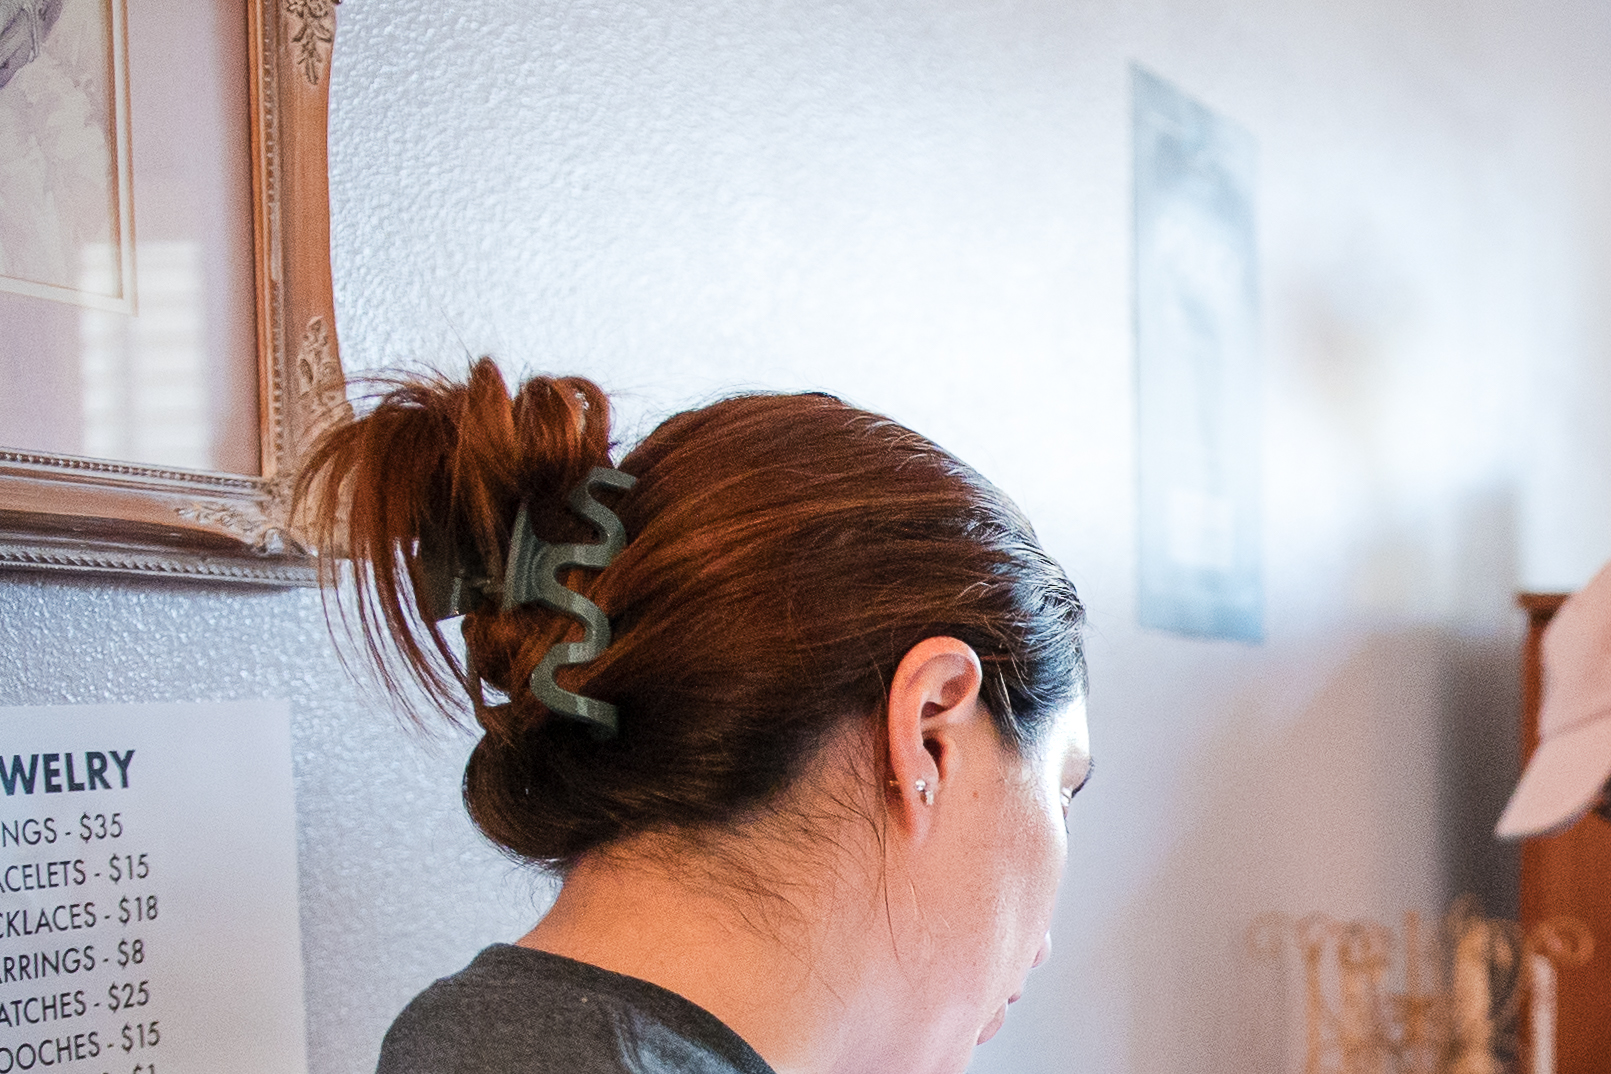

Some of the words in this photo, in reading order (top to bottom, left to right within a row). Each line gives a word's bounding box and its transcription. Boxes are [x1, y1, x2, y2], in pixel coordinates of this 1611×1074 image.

[0, 749, 136, 796] WELRY
[1, 817, 57, 847] NGS
[79, 812, 123, 844] $35
[108, 853, 149, 884] $15
[118, 895, 158, 926] $18
[0, 945, 96, 984] RRINGS
[117, 938, 145, 970] $8
[0, 990, 87, 1027] ATCHES
[107, 980, 149, 1013] $25
[0, 1031, 100, 1074] OOCHES
[121, 1020, 161, 1053] $15
